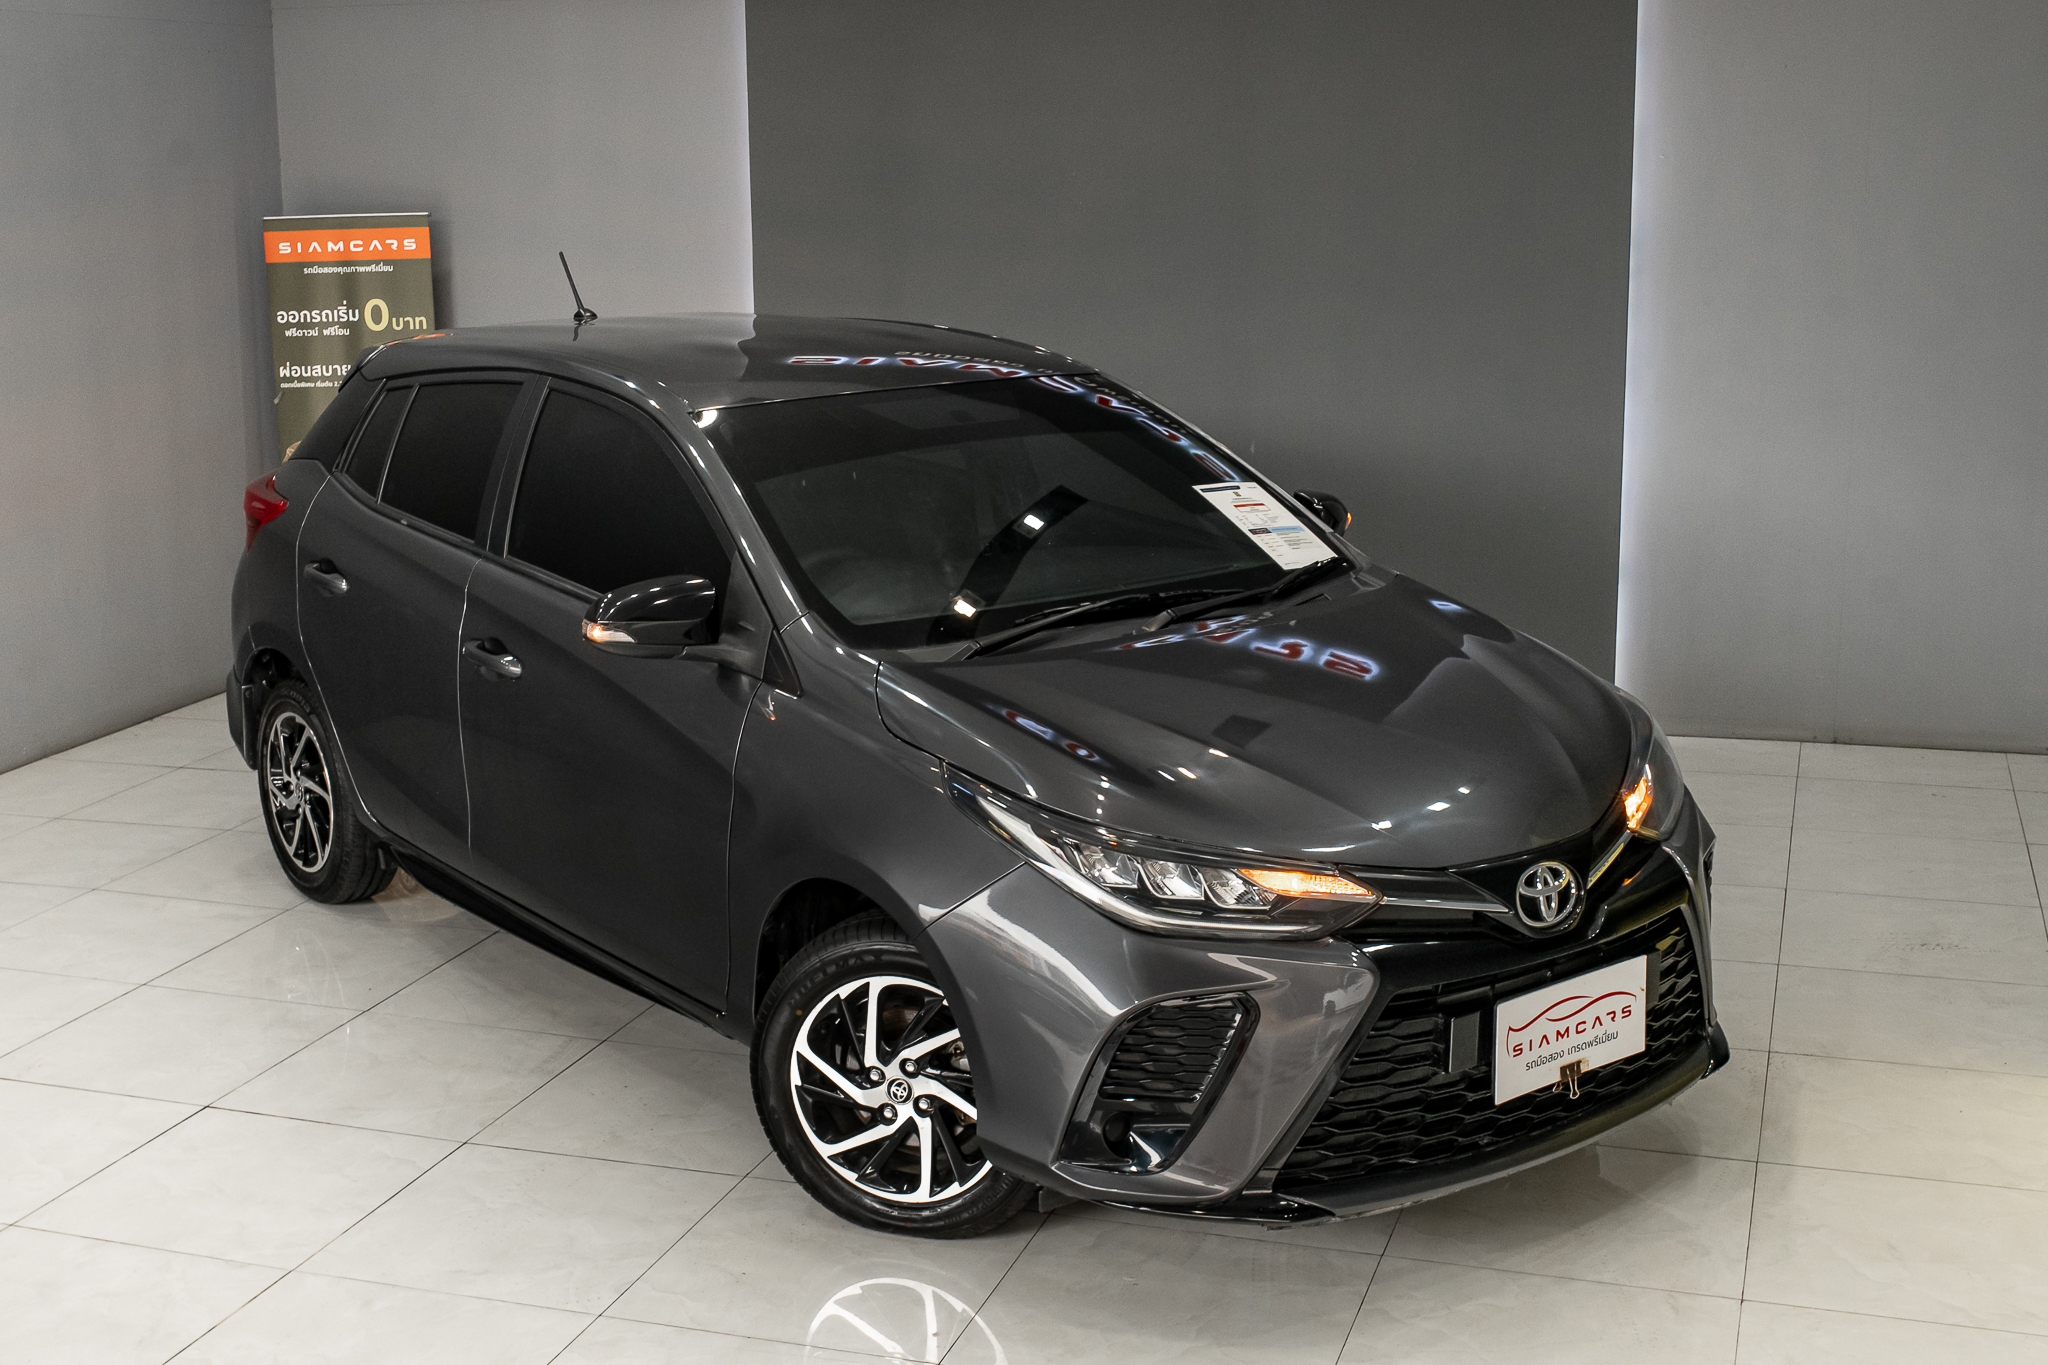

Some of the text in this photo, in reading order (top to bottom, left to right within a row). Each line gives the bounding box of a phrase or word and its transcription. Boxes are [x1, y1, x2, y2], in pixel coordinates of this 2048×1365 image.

[278, 238, 417, 255] SIAMCARS
[276, 298, 428, 332] ออกรถเริ่ม 0 บาท
[284, 325, 350, 337] ฟรีดาวน์ ฟรีโอน
[1512, 1004, 1633, 1058] SIAMCARS
[1525, 1029, 1619, 1071] รถมือสอง เกรดพรีเมี่ยม
